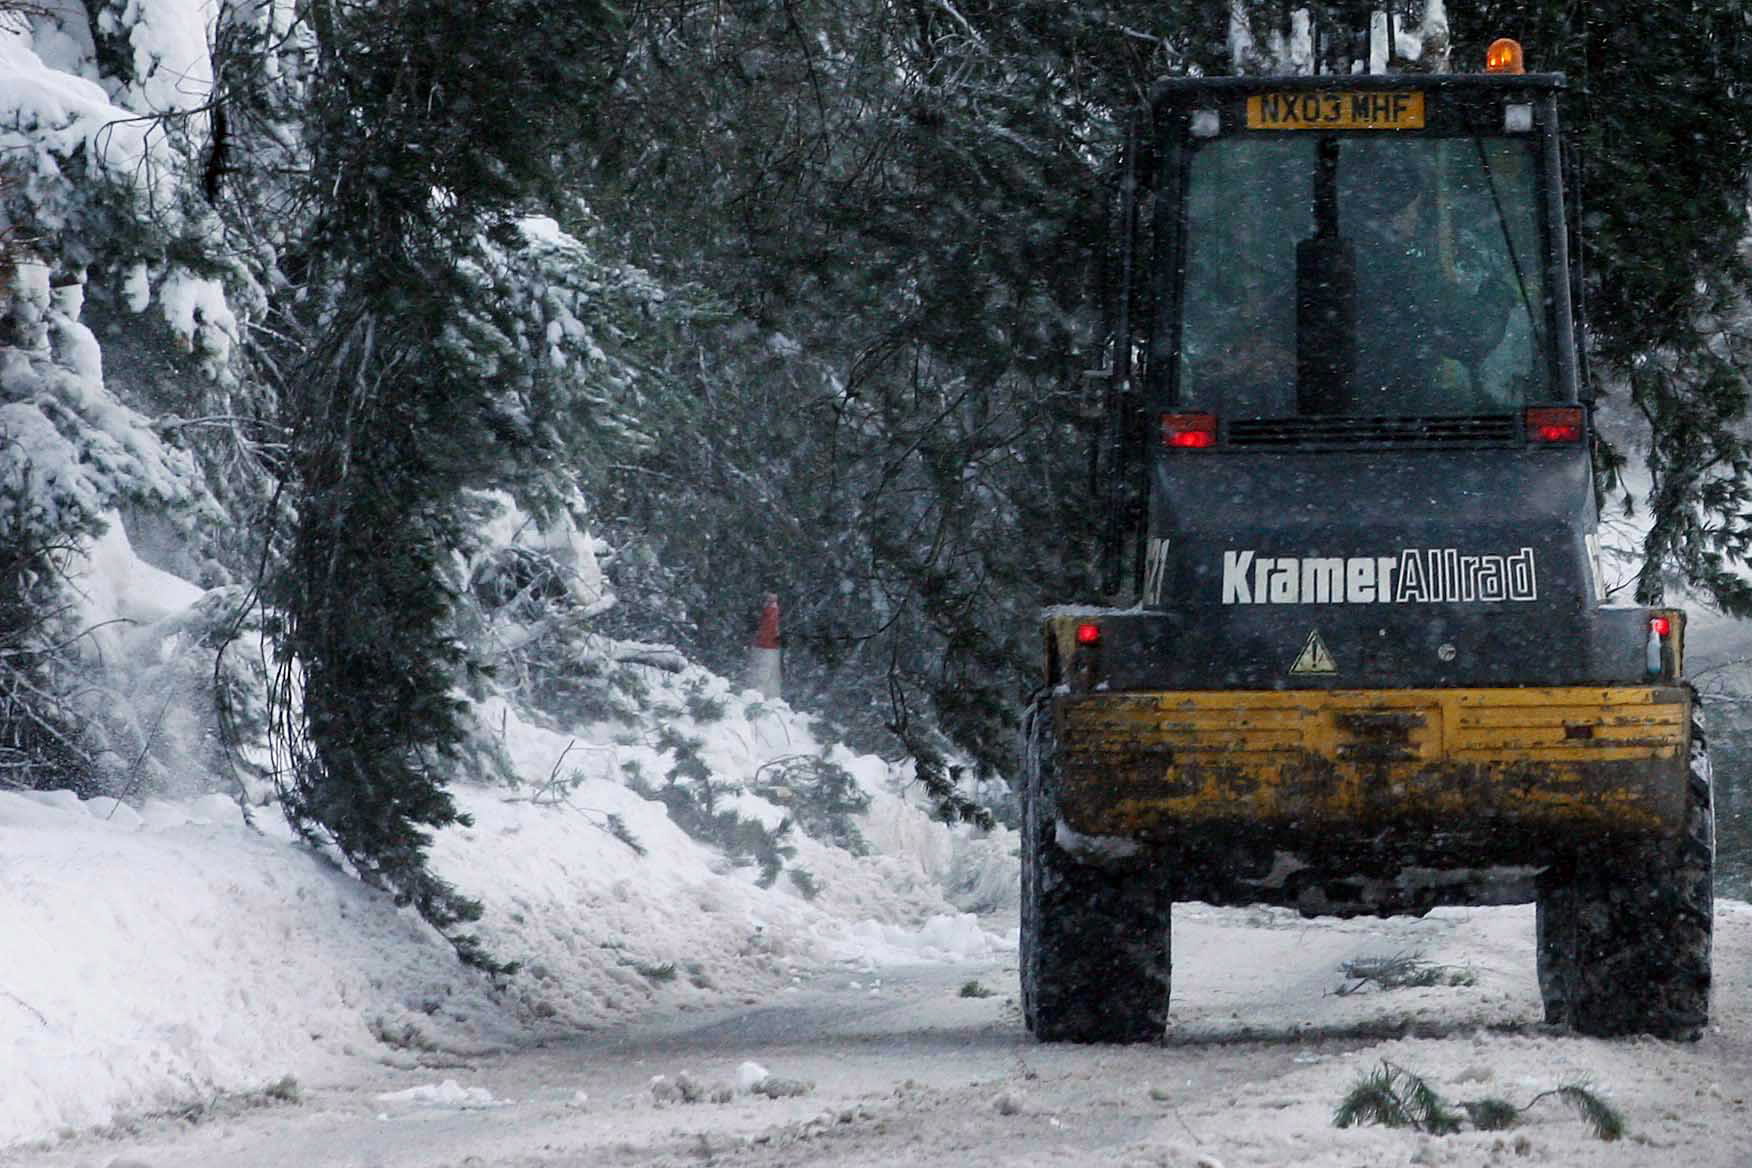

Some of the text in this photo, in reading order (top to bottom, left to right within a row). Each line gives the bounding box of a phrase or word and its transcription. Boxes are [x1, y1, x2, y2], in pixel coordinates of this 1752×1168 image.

[1260, 94, 1412, 123] NX03 MHF
[1221, 547, 1538, 605] KramerAllrad
